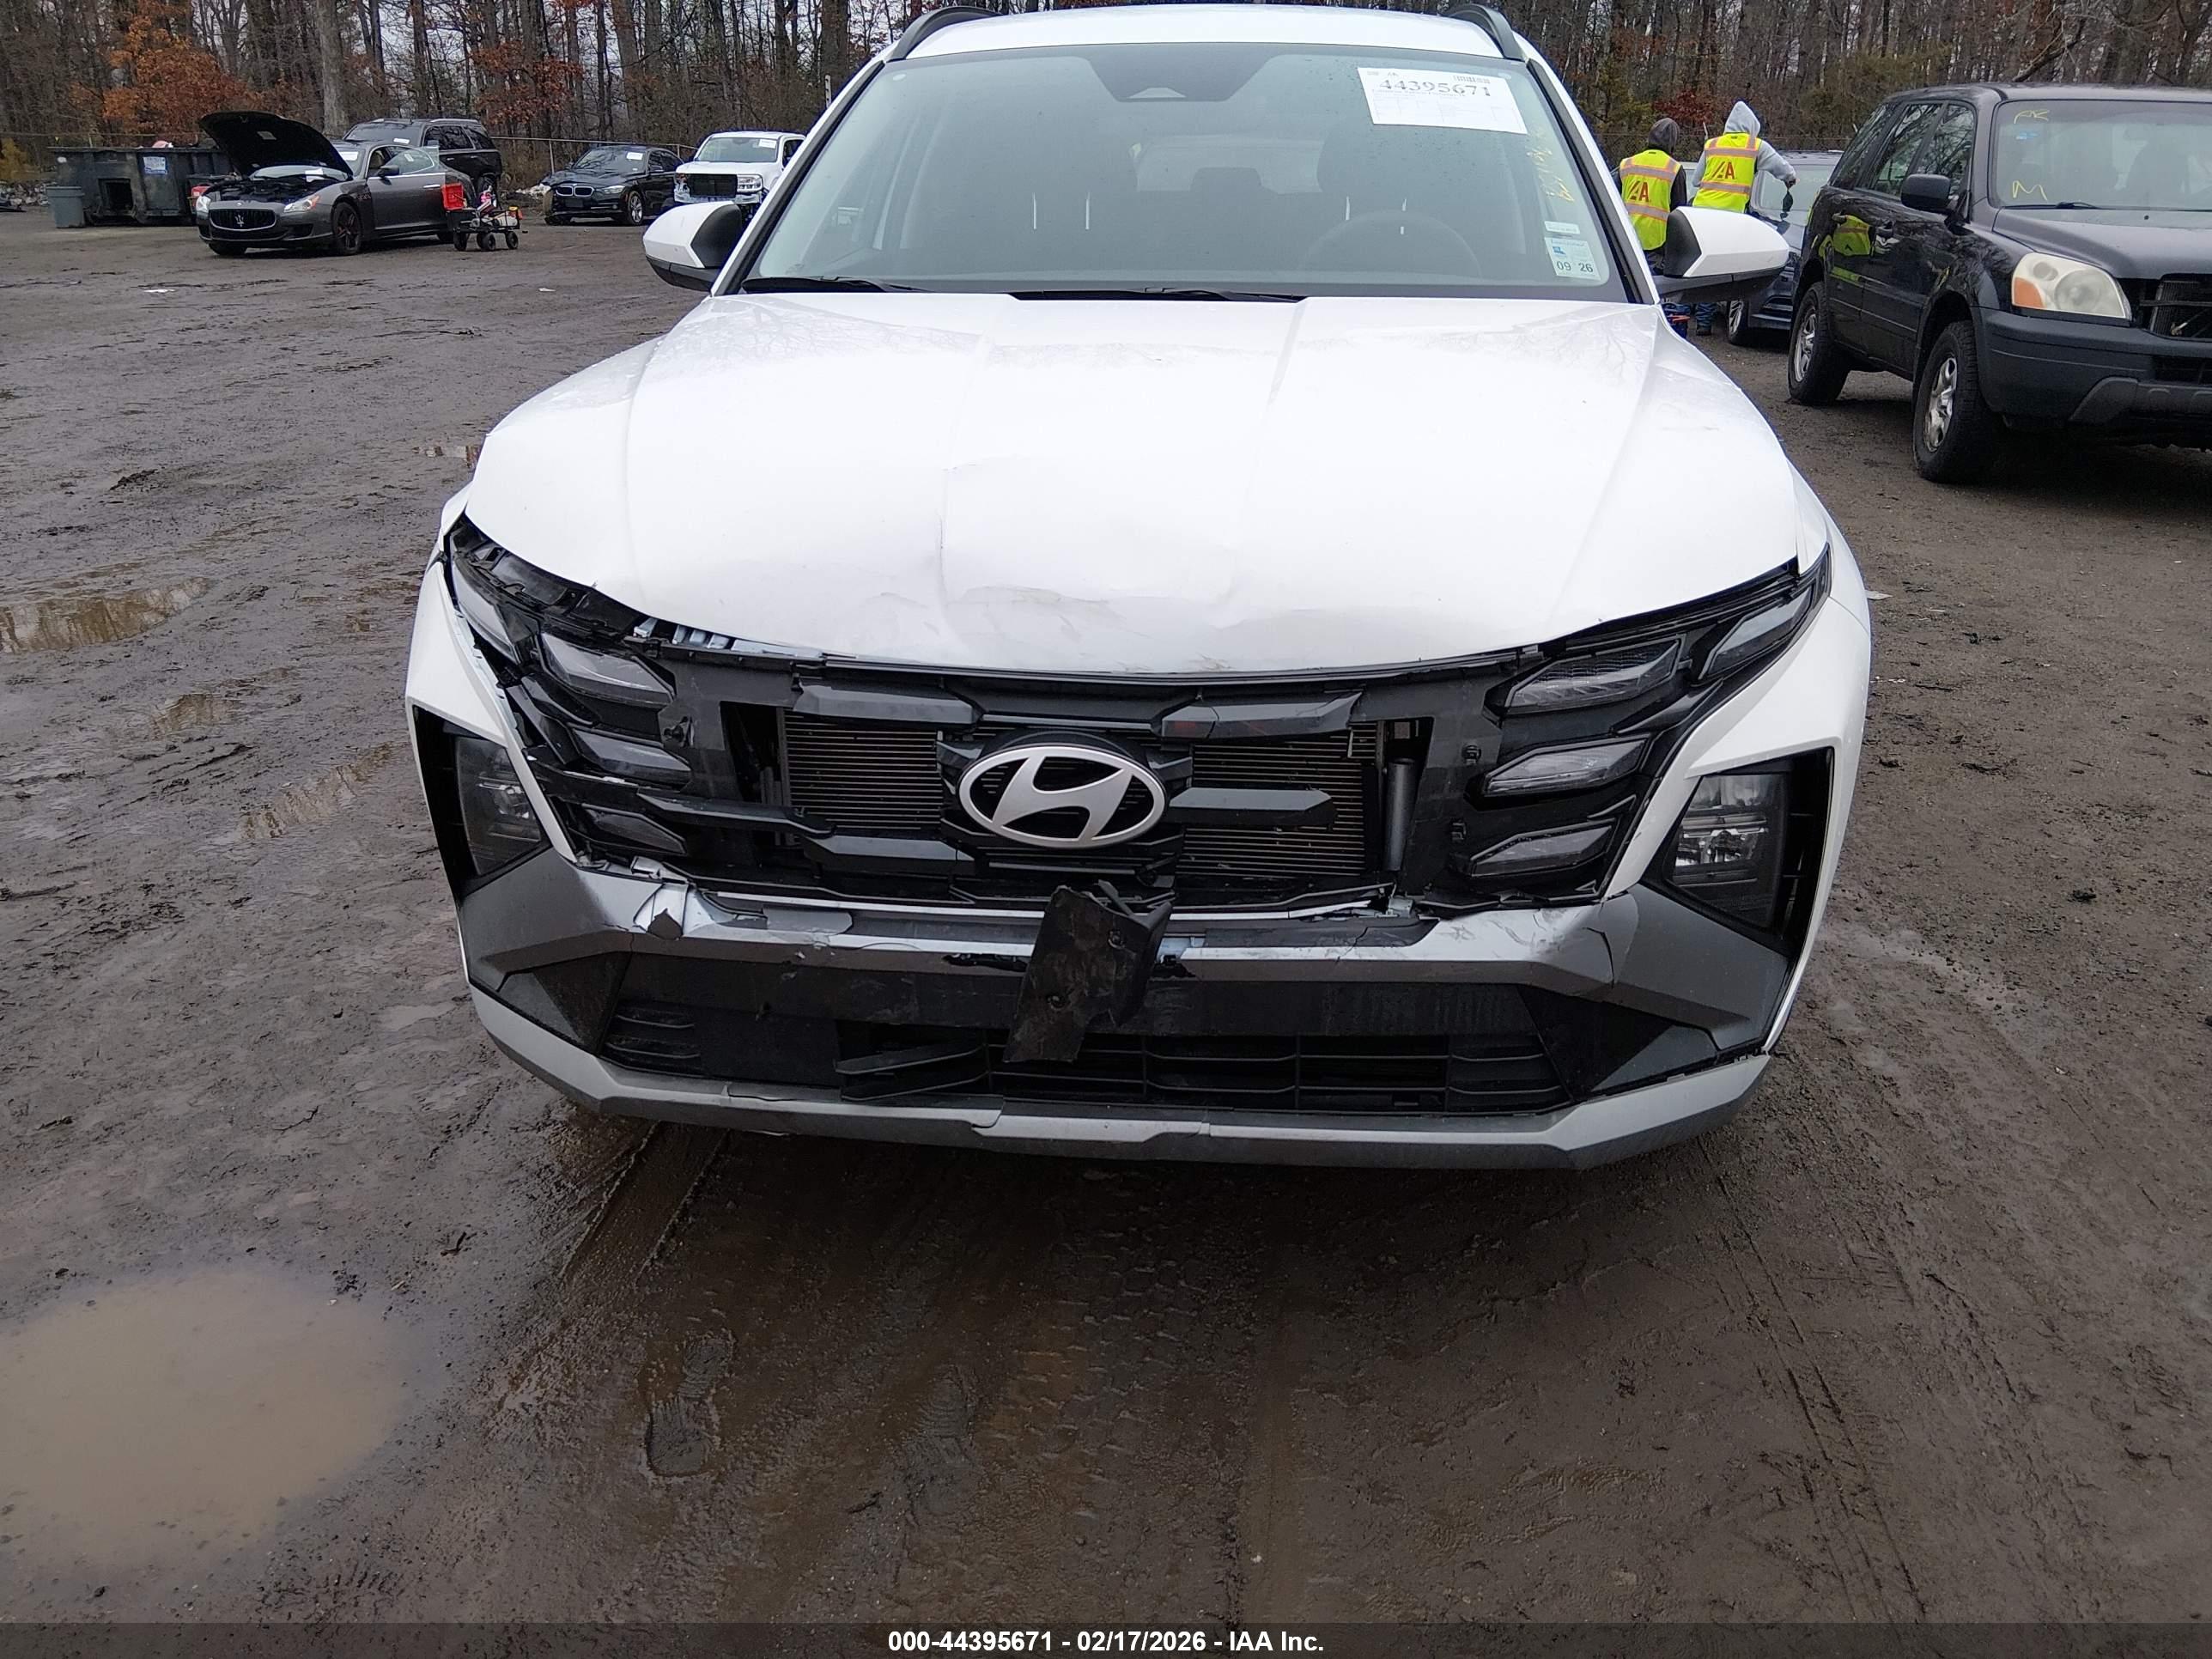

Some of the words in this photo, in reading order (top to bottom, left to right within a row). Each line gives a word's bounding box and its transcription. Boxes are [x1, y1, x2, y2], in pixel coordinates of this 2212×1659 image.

[1379, 79, 1491, 97] 44395671
[1556, 260, 1572, 271] 09
[1578, 261, 1594, 273] 26
